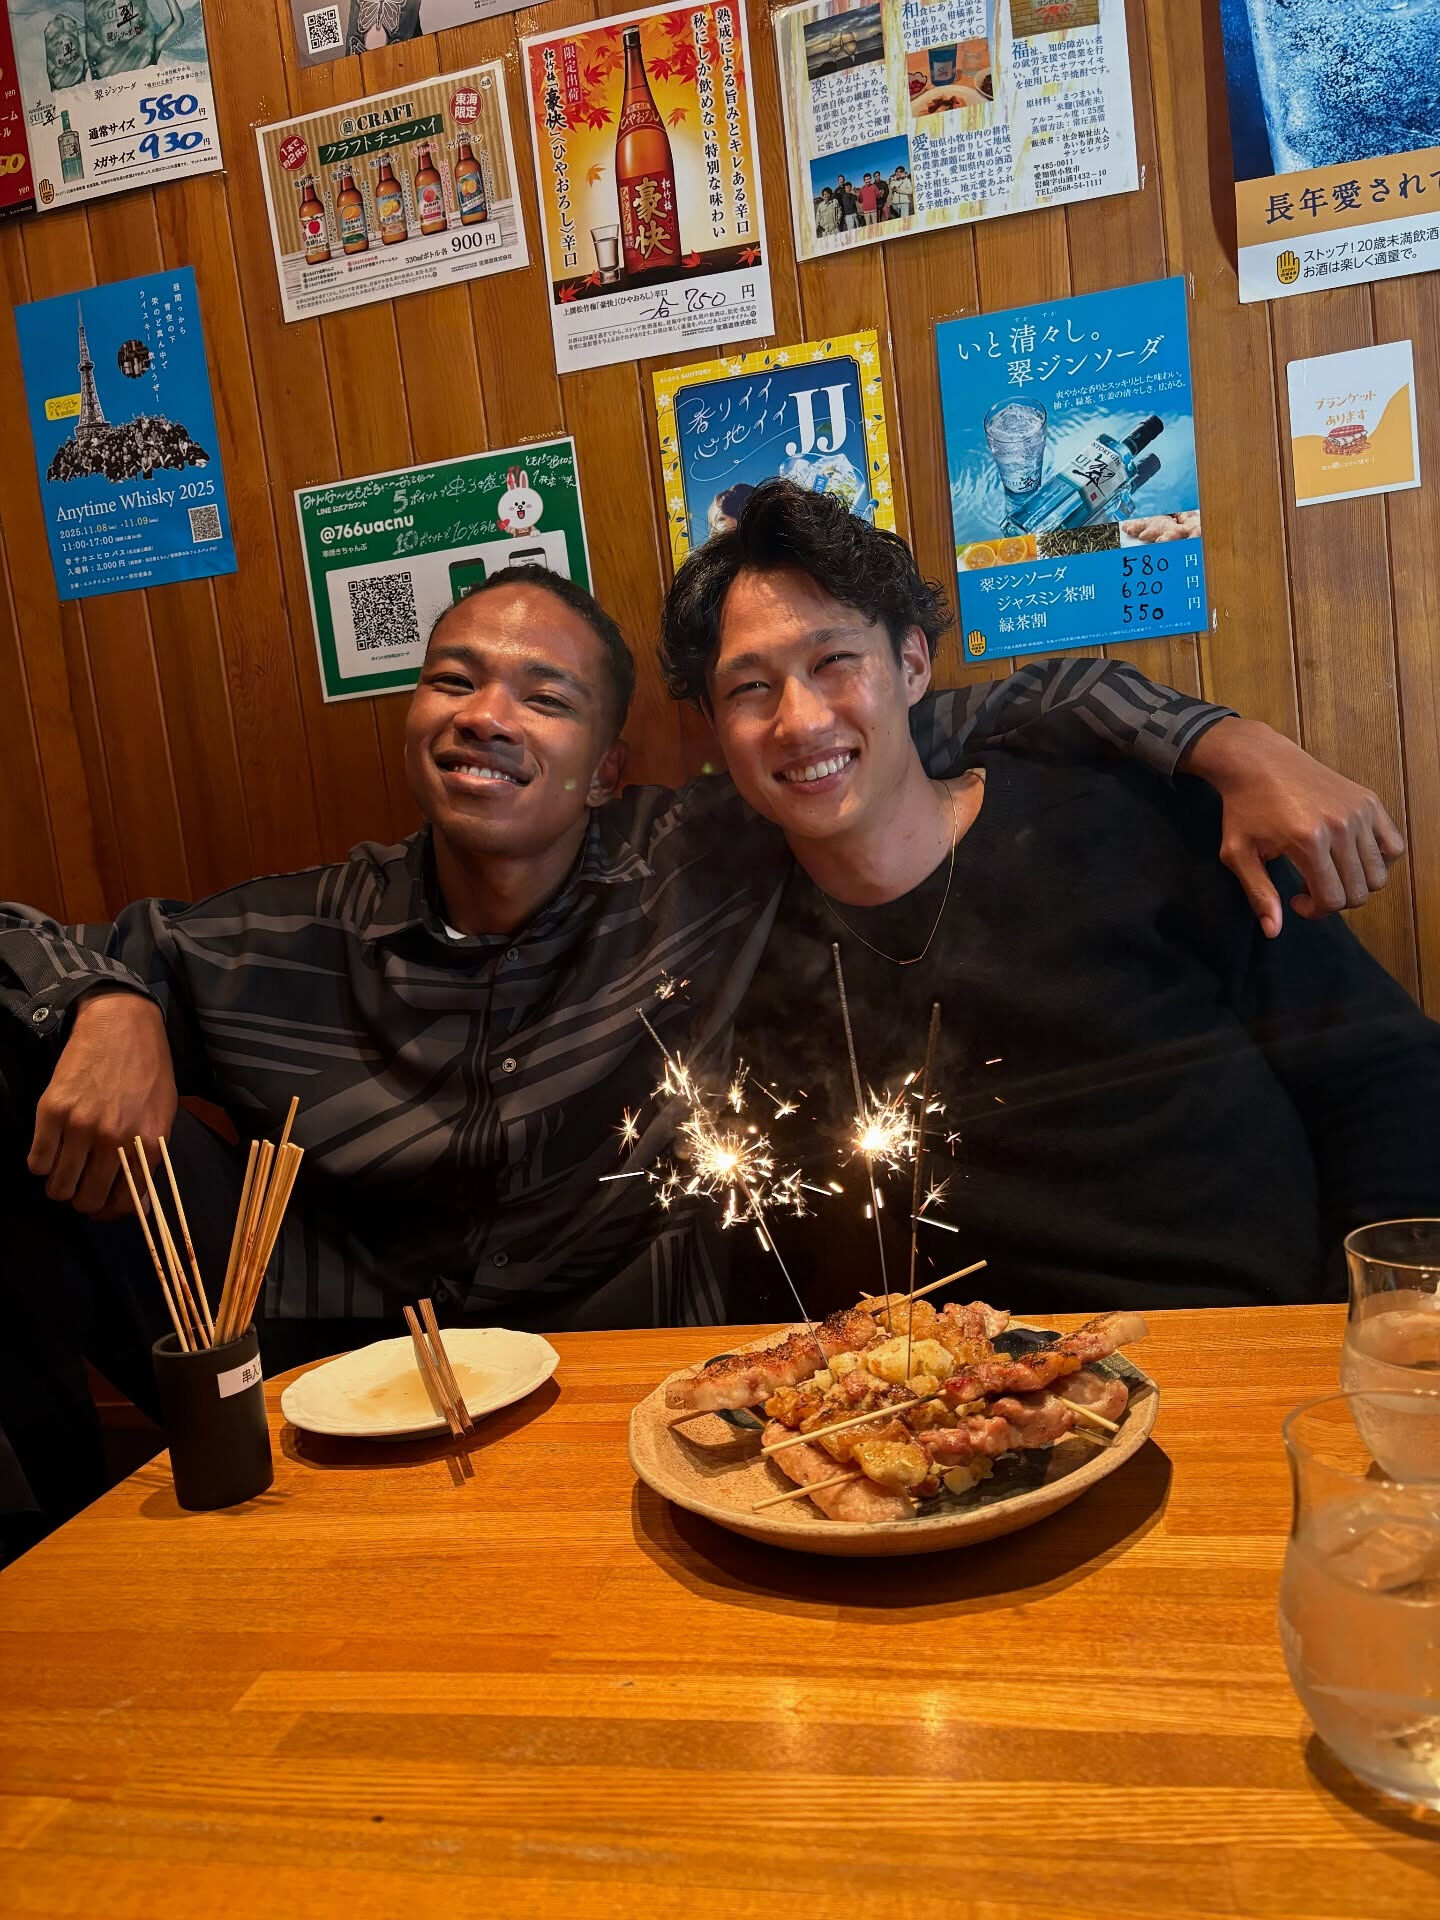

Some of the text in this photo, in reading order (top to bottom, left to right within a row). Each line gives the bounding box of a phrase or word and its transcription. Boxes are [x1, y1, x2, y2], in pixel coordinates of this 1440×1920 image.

[563, 45, 579, 102] 限定出荷
[4, 89, 16, 100] yen
[454, 92, 478, 106] 東海
[88, 93, 207, 141] 通常サイズ 580 円
[357, 103, 414, 131] CRAFT
[454, 106, 477, 119] 限定
[693, 13, 726, 238] 秋にしか飲めない特別な味わい
[717, 9, 749, 234] 熟成による旨みとキレある辛口
[93, 149, 136, 172] メガサイズ
[138, 131, 204, 160] 930
[203, 137, 211, 147] 円
[325, 117, 436, 162] クラフトチューハイ
[911, 124, 1010, 152] 愛知県小牧市内の耕作
[633, 176, 673, 259] 豪快
[451, 232, 482, 253] 900
[485, 233, 496, 246] 円
[1303, 248, 1418, 279] お酒は楽しく適量で。
[685, 288, 726, 312] 750
[742, 283, 755, 299] 円
[151, 297, 168, 369] 栄のど真ん中で
[164, 303, 176, 343] 青空の下
[958, 319, 1100, 360] いと清々し。
[681, 368, 712, 379] SUNTORY
[1007, 334, 1165, 388] 翠ジンソーダ
[1055, 371, 1182, 399] 爽やかな香りとスッキリとした味わい。
[1314, 390, 1377, 411] ブランケット
[786, 383, 851, 457] JJ
[1325, 408, 1368, 426] あります
[56, 480, 215, 523] Anytime Whisky 2025
[60, 523, 107, 539] 2025.11.08
[62, 535, 114, 552] 11:00-17:00
[320, 514, 414, 544] @766uacnu
[979, 553, 1199, 594] 翠ジンソーダ 580 円
[996, 575, 1200, 612] ジャスミン茶割 620 円
[999, 596, 1201, 633] 緑茶割 550 円
